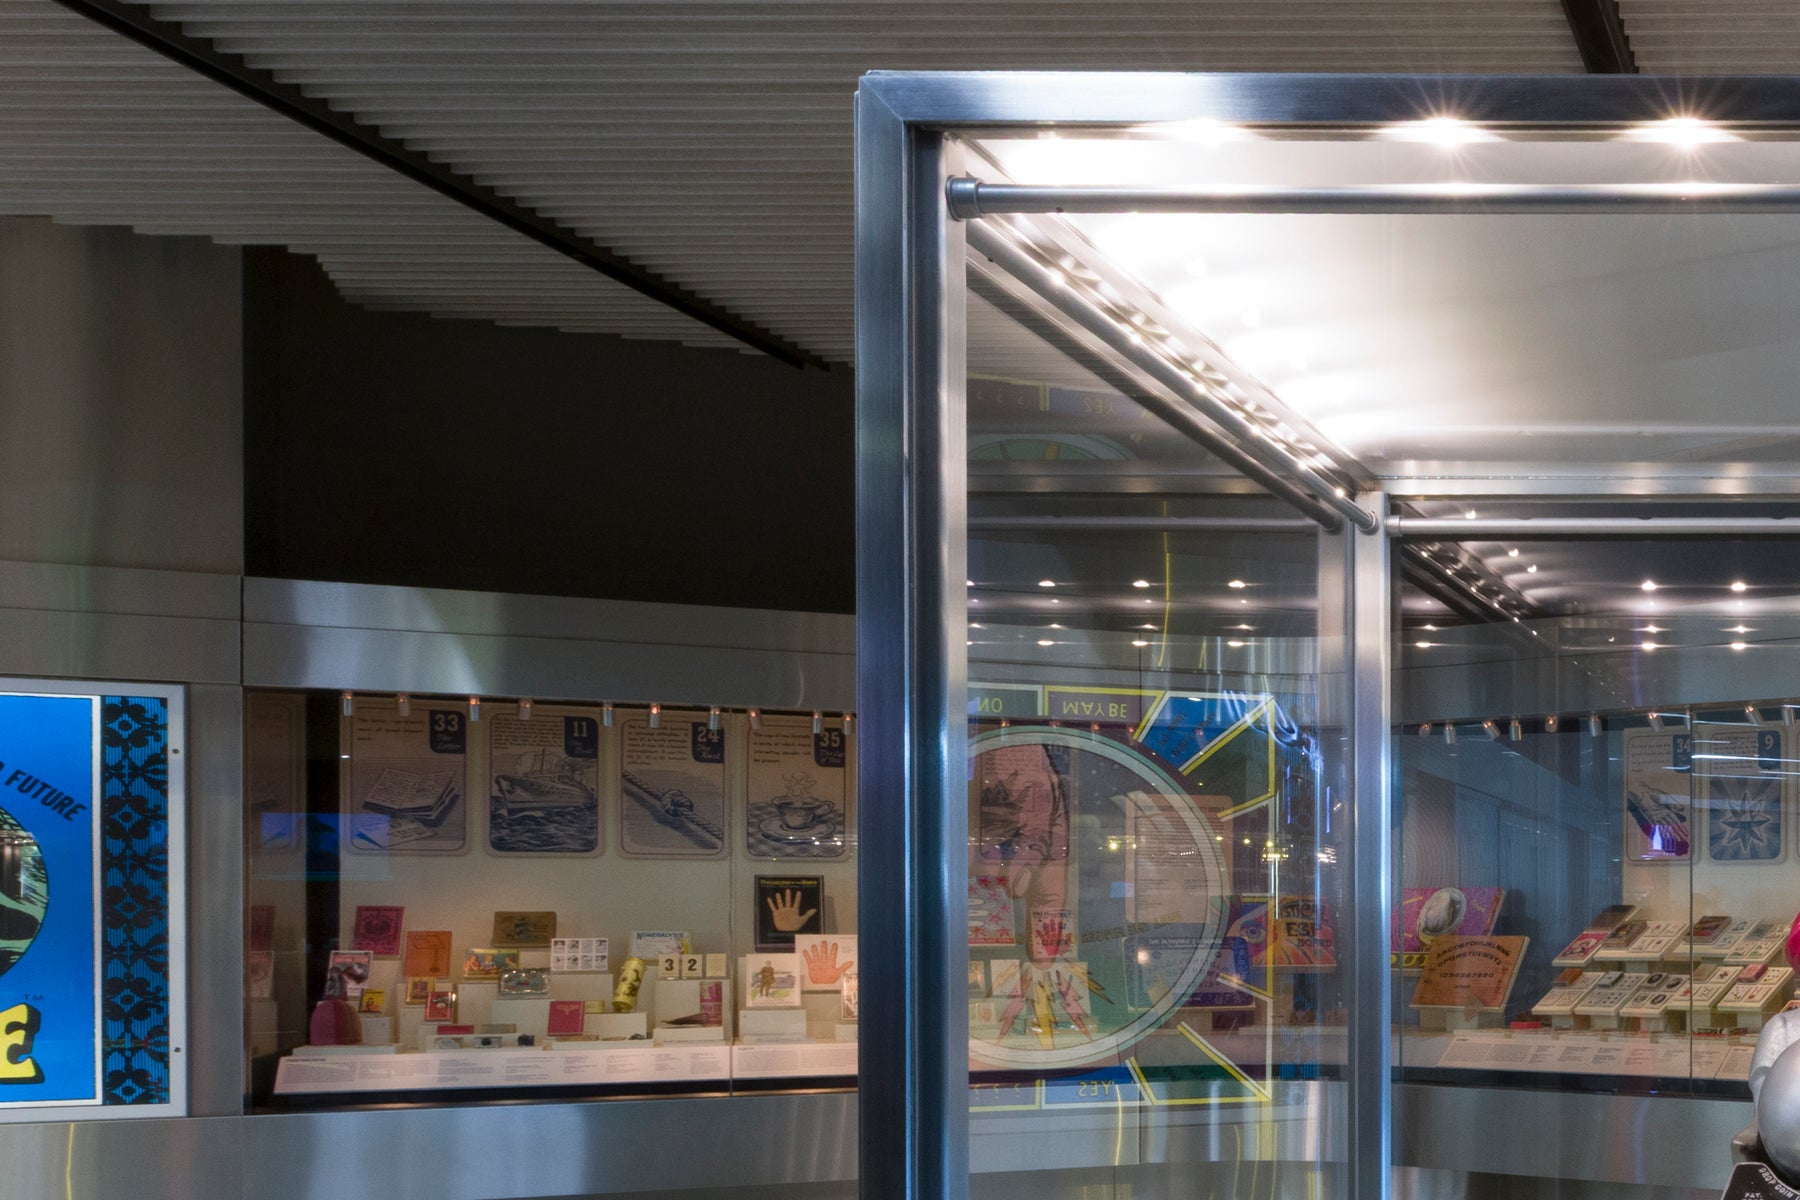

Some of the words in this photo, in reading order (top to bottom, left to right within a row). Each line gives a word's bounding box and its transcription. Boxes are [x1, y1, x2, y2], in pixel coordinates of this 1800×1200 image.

[434, 714, 459, 732] 33
[572, 721, 588, 738] 11
[697, 727, 720, 743] 24
[820, 731, 840, 748] 35
[1763, 736, 1774, 751] 9
[4, 769, 87, 822] FUTURE
[664, 958, 675, 972] 3
[687, 958, 697, 972] 2
[1758, 1166, 1775, 1186] DROP
[1774, 1182, 1794, 1199] COIN
